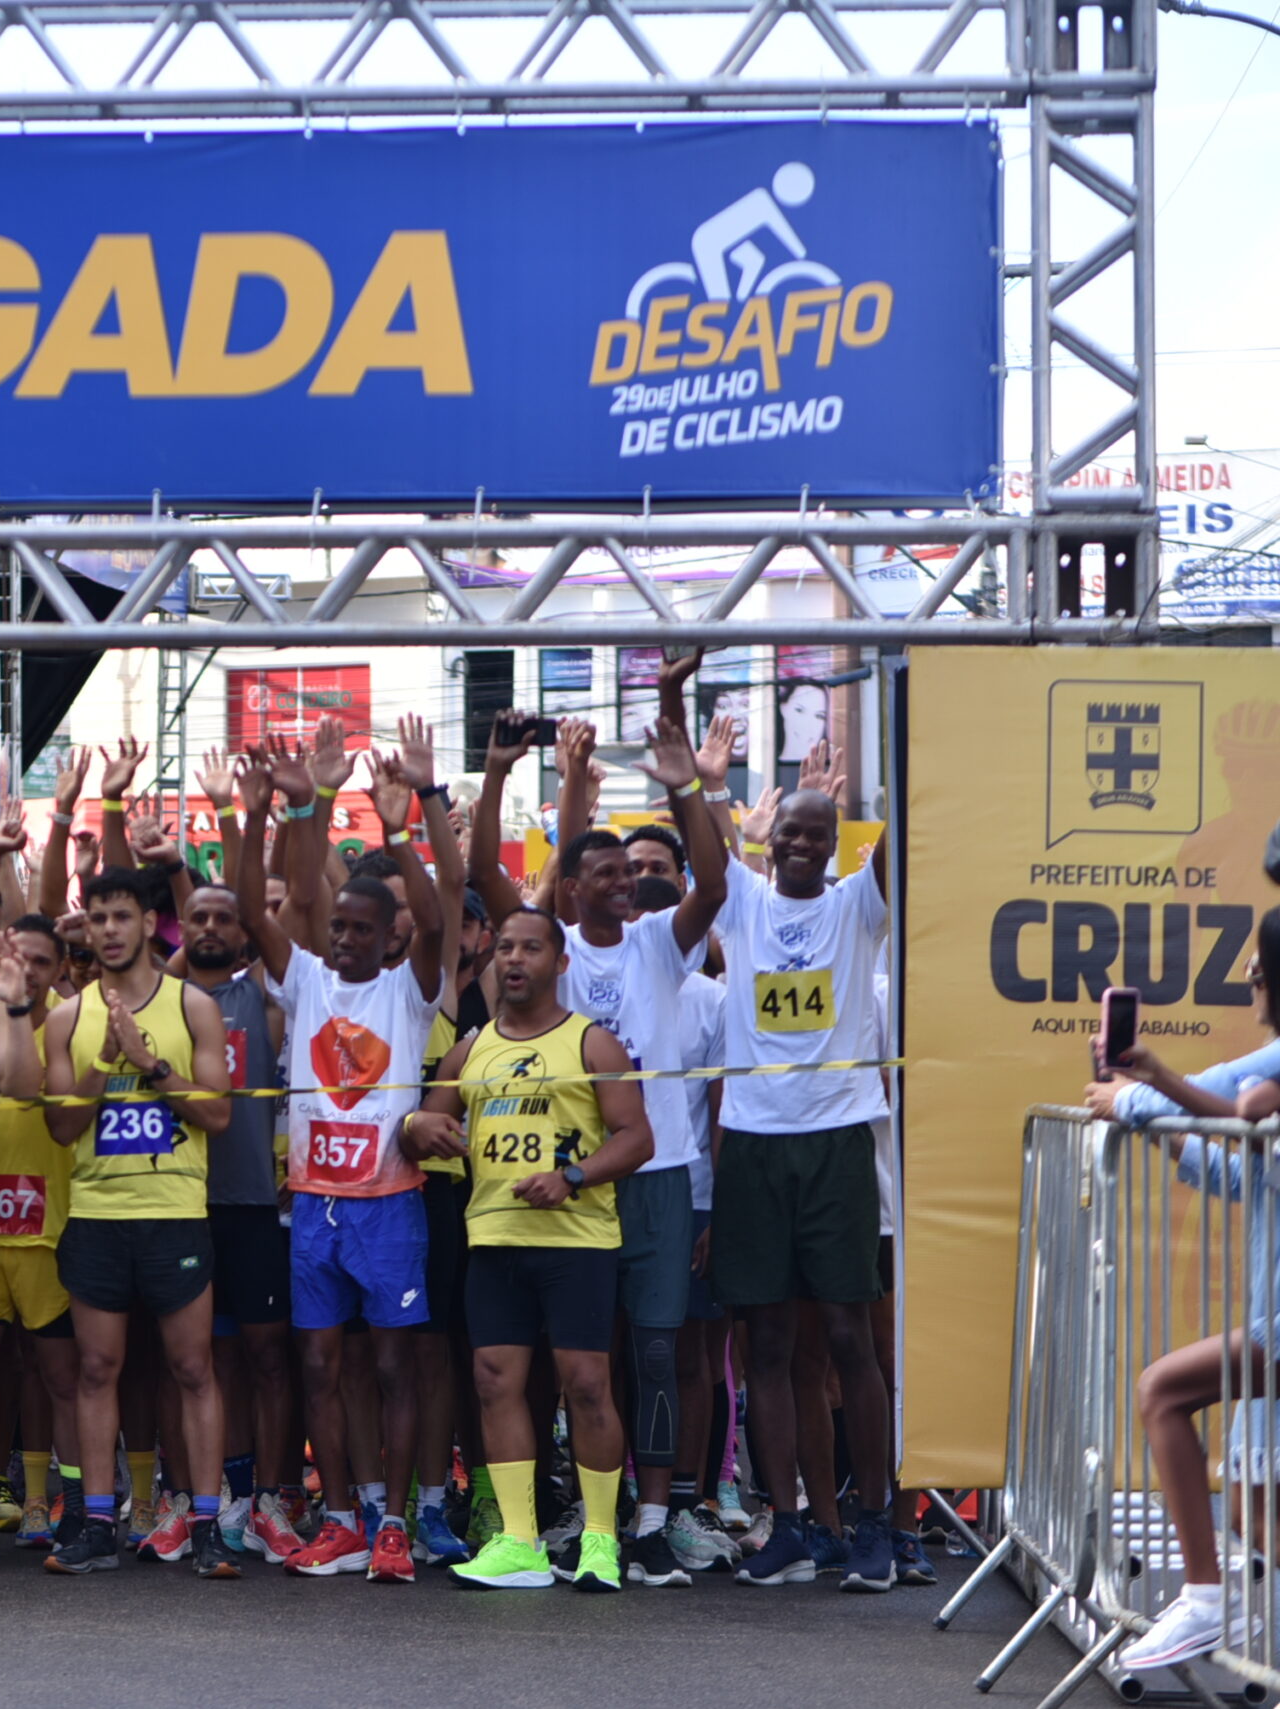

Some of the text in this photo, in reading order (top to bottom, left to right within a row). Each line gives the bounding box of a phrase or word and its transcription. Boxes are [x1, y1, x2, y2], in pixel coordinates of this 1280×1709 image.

[589, 280, 894, 392] DESAFIO
[609, 383, 646, 416] 29
[667, 368, 759, 415] JULHO
[619, 395, 844, 458] DE CICLISMO
[1122, 463, 1232, 495] AMEIDA
[1030, 864, 1217, 888] PREFEITURA DE
[989, 898, 1254, 1007] CRUZ
[761, 986, 825, 1018] 414
[1032, 1017, 1211, 1036] AQUI TE ABALHO
[518, 1097, 552, 1116] RUN
[100, 1107, 165, 1141] 236
[312, 1133, 370, 1169] 357
[483, 1132, 542, 1164] 428
